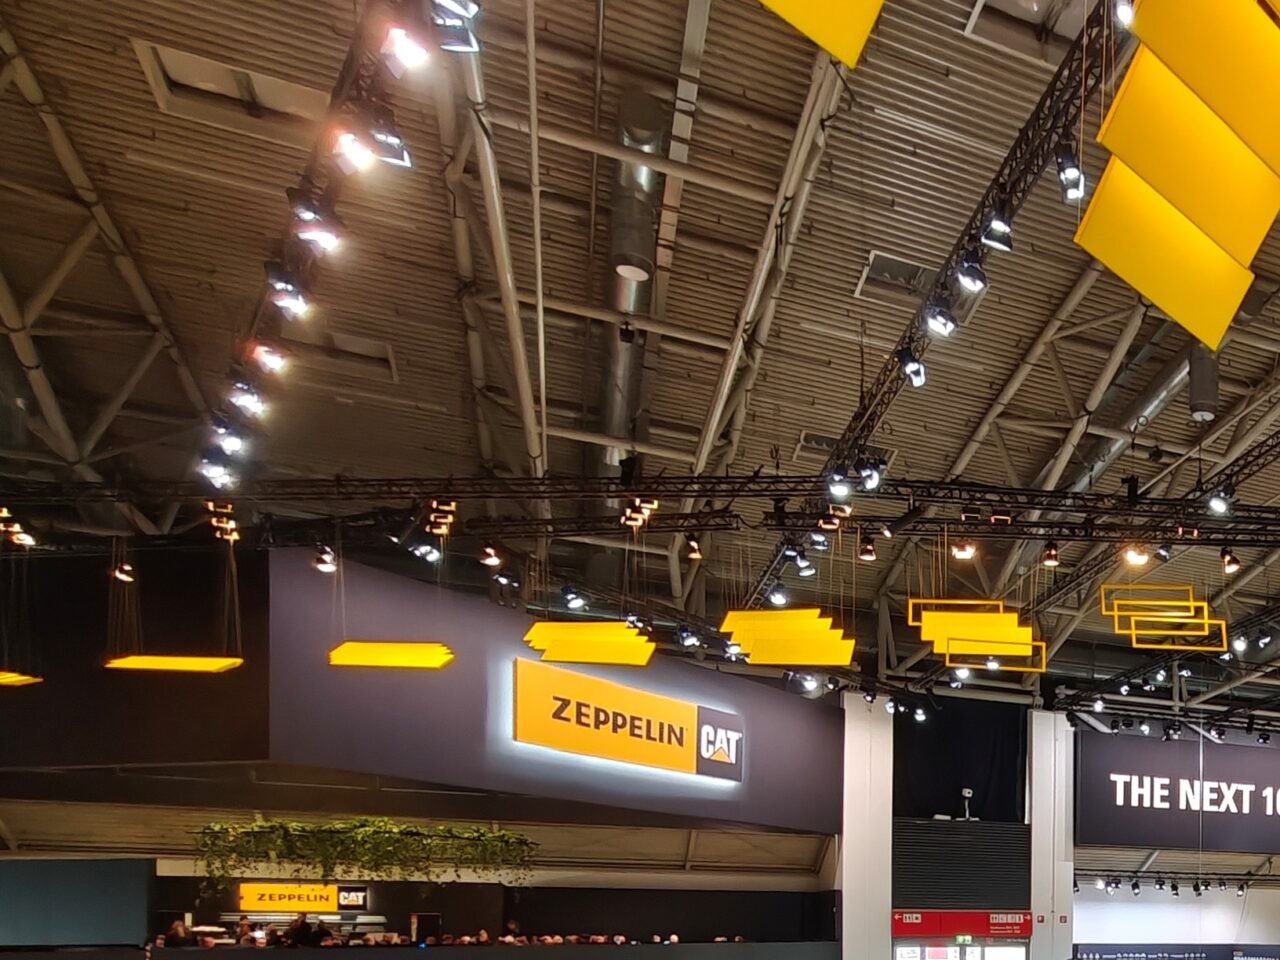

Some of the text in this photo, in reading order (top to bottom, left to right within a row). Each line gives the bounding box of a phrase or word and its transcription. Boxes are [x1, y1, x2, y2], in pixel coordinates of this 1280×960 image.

[552, 695, 742, 764] ZEPPELIN CAT
[1110, 773, 1170, 809] THE
[1179, 779, 1255, 814] NEXT
[257, 892, 366, 905] ZEPPELIN CAT
